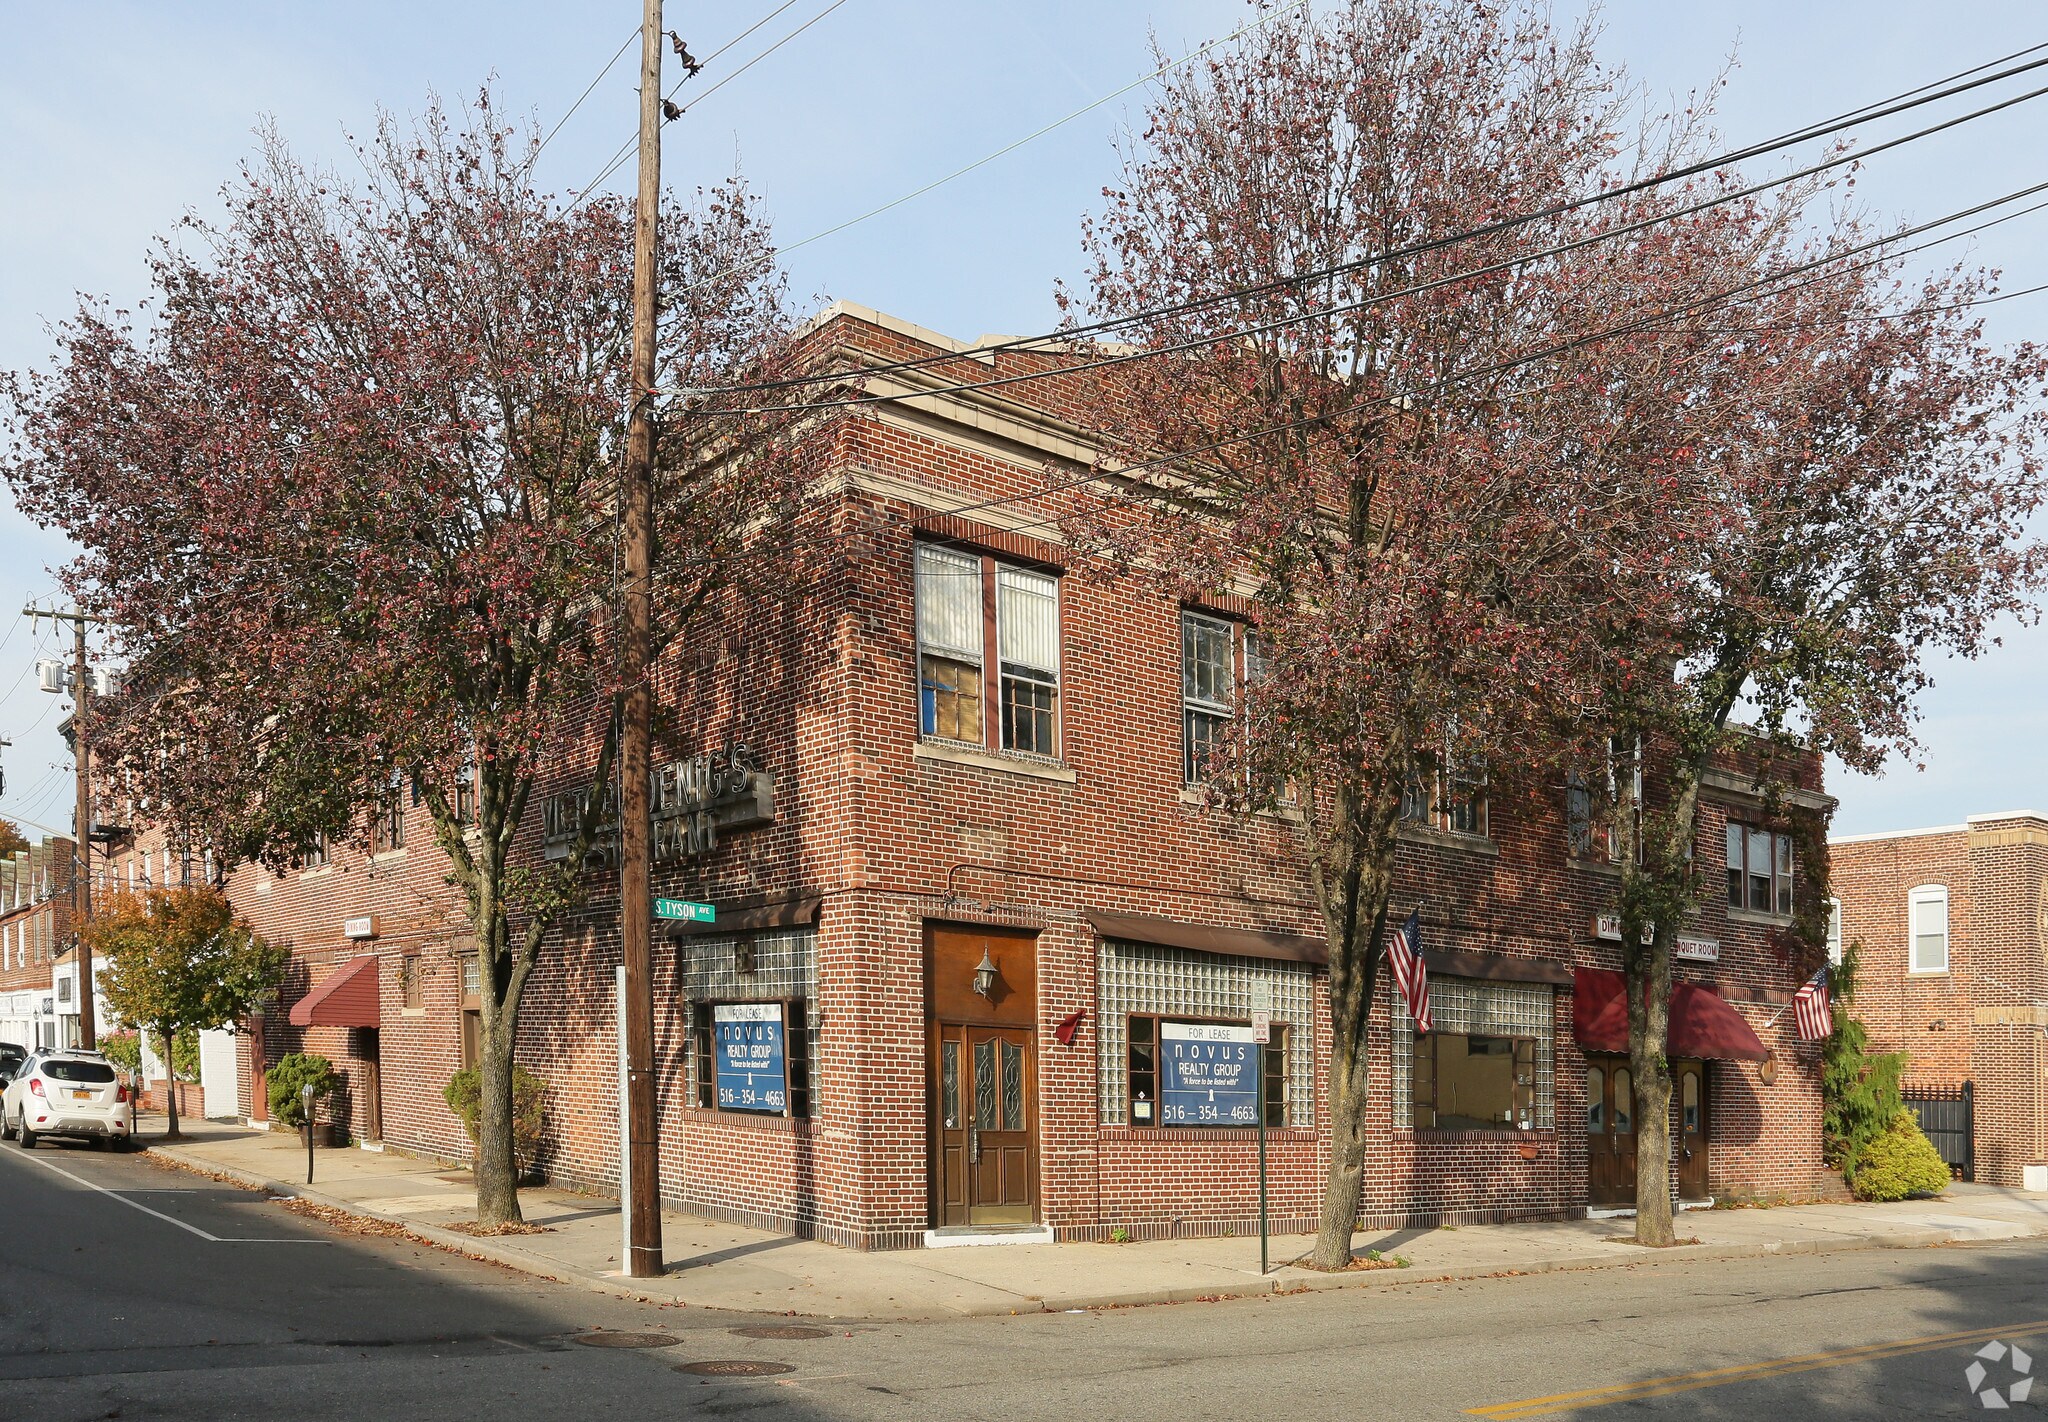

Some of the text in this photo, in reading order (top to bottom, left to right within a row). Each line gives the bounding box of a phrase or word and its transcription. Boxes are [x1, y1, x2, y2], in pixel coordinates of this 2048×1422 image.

[655, 900, 710, 918] S. TYSON AVE
[1602, 920, 1621, 934] DINI
[1677, 941, 1717, 956] NQUET ROOM
[733, 1008, 762, 1019] FOR LEASE
[724, 1026, 774, 1040] novus
[1189, 1028, 1230, 1039] FOR LEASE
[727, 1045, 771, 1058] REALTY GROUP
[1175, 1044, 1245, 1060] novus
[1179, 1062, 1241, 1076] REALTY GROUP
[1189, 1077, 1200, 1085] force
